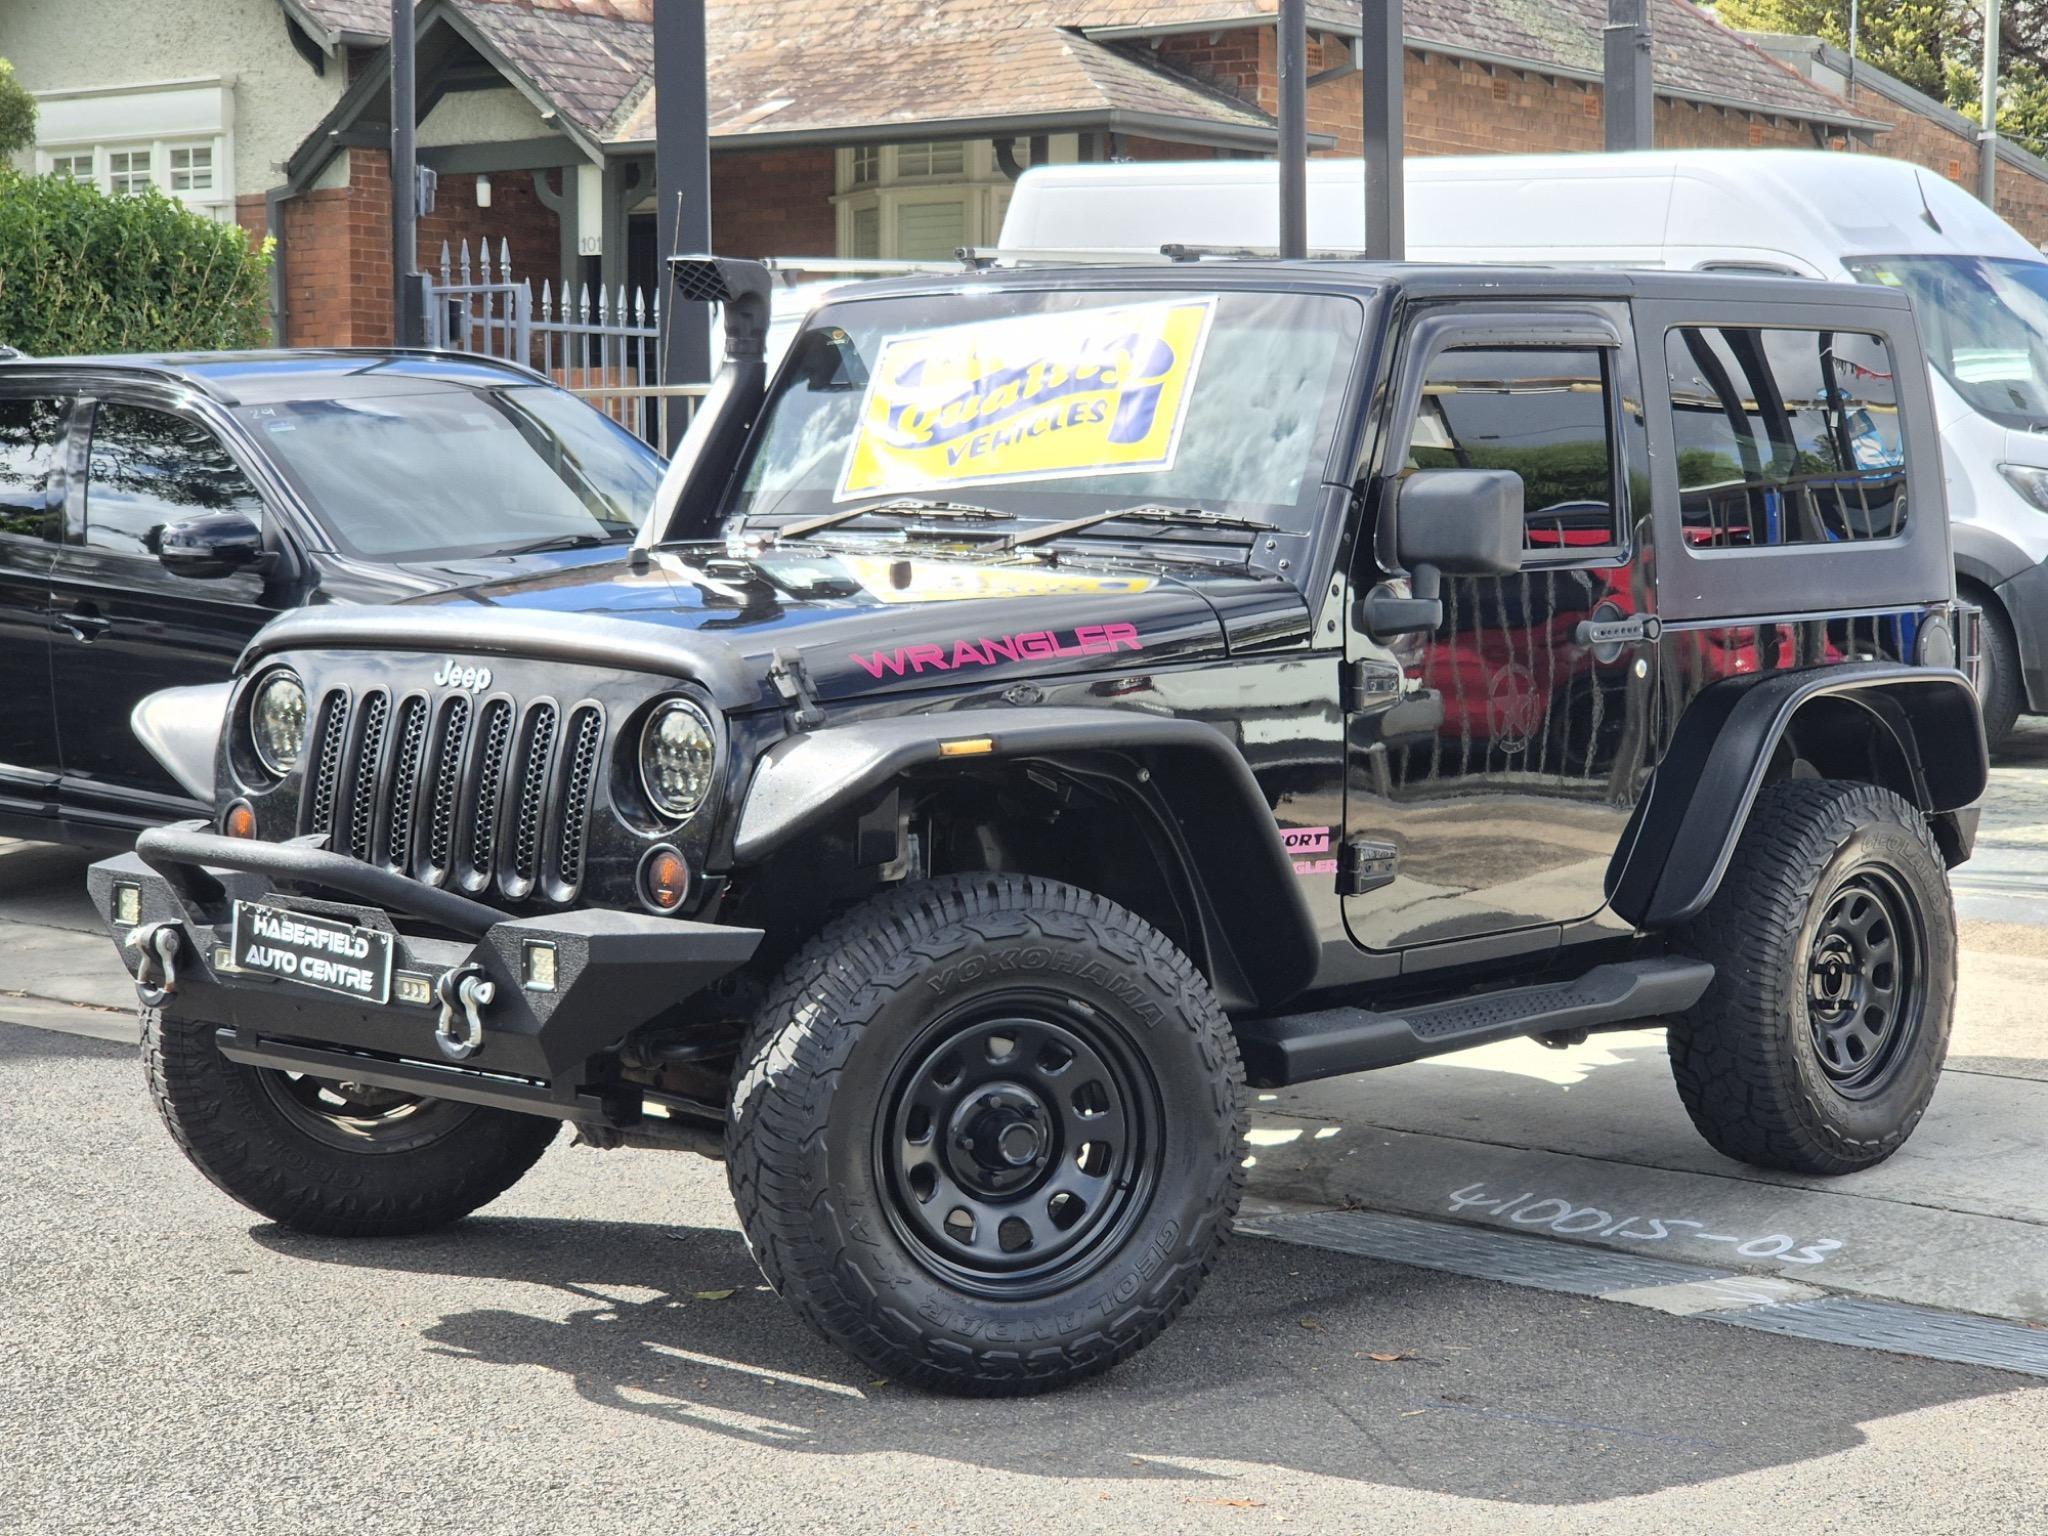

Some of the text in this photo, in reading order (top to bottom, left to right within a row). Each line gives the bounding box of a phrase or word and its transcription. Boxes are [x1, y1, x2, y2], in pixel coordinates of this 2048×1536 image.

[946, 400, 1108, 466] VEHICLES
[433, 659, 492, 694] Jeep
[849, 623, 1144, 679] WRANGLER
[1282, 833, 1328, 847] ORT
[253, 915, 369, 960] HABERFIELD
[245, 944, 375, 992] AUTO CENTRE
[926, 947, 1165, 1029] YOKOHAMA
[915, 1218, 1181, 1342] GEOLANDAR
